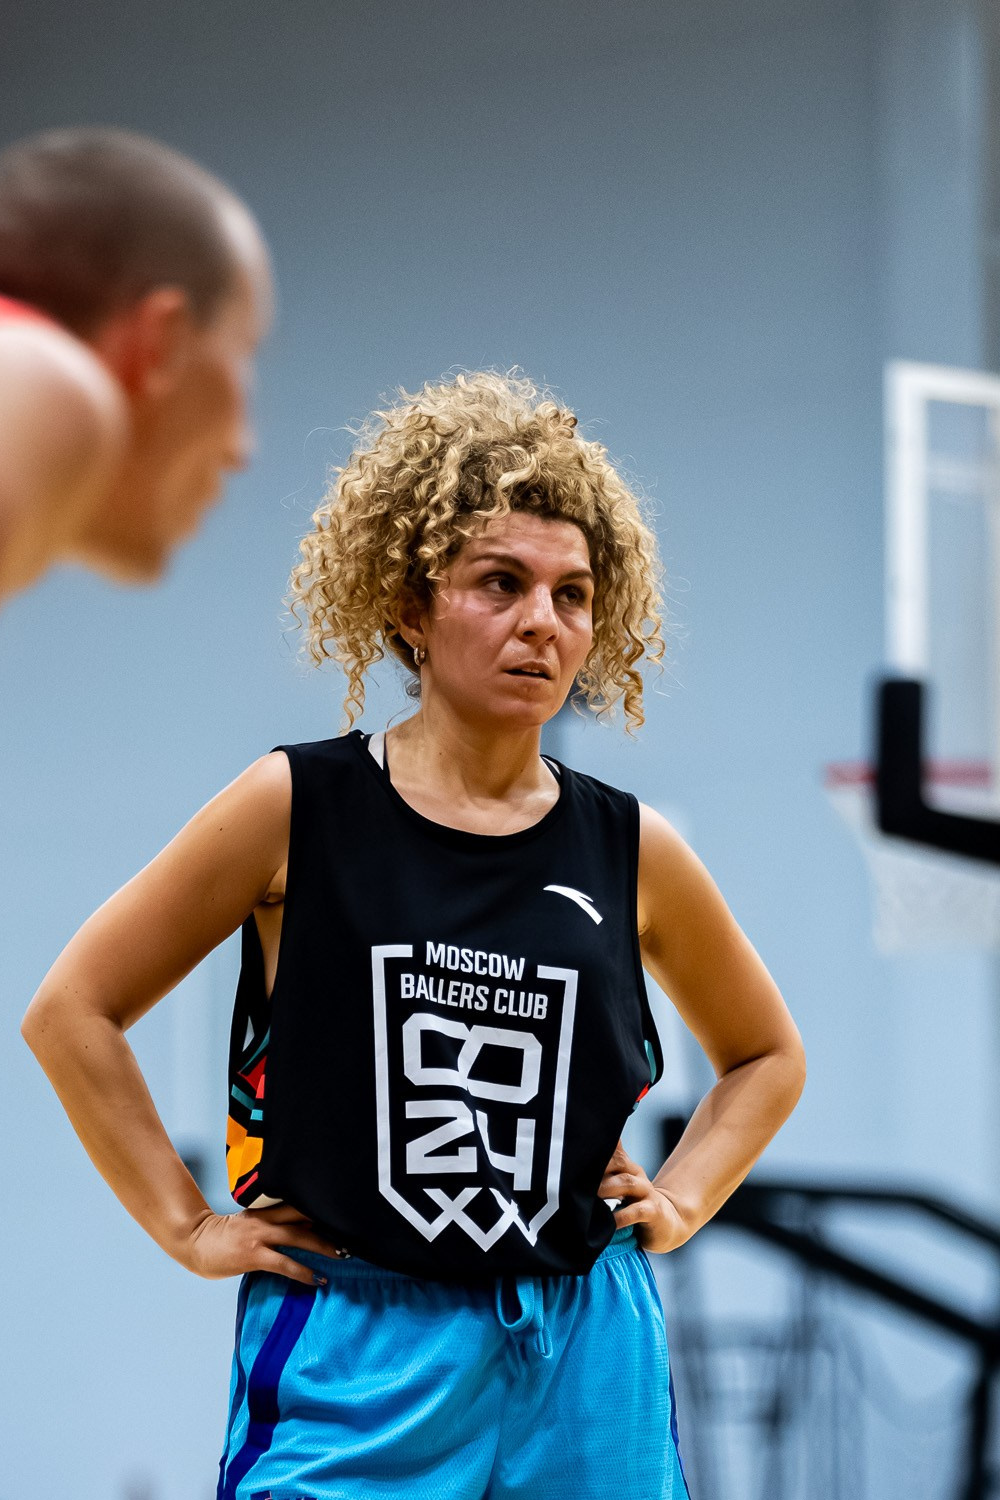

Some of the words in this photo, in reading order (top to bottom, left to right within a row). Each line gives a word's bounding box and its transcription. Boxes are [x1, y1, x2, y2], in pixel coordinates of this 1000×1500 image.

[426, 941, 525, 981] MOSCOW
[401, 973, 490, 1012] BALLERS
[495, 989, 549, 1020] CLUB
